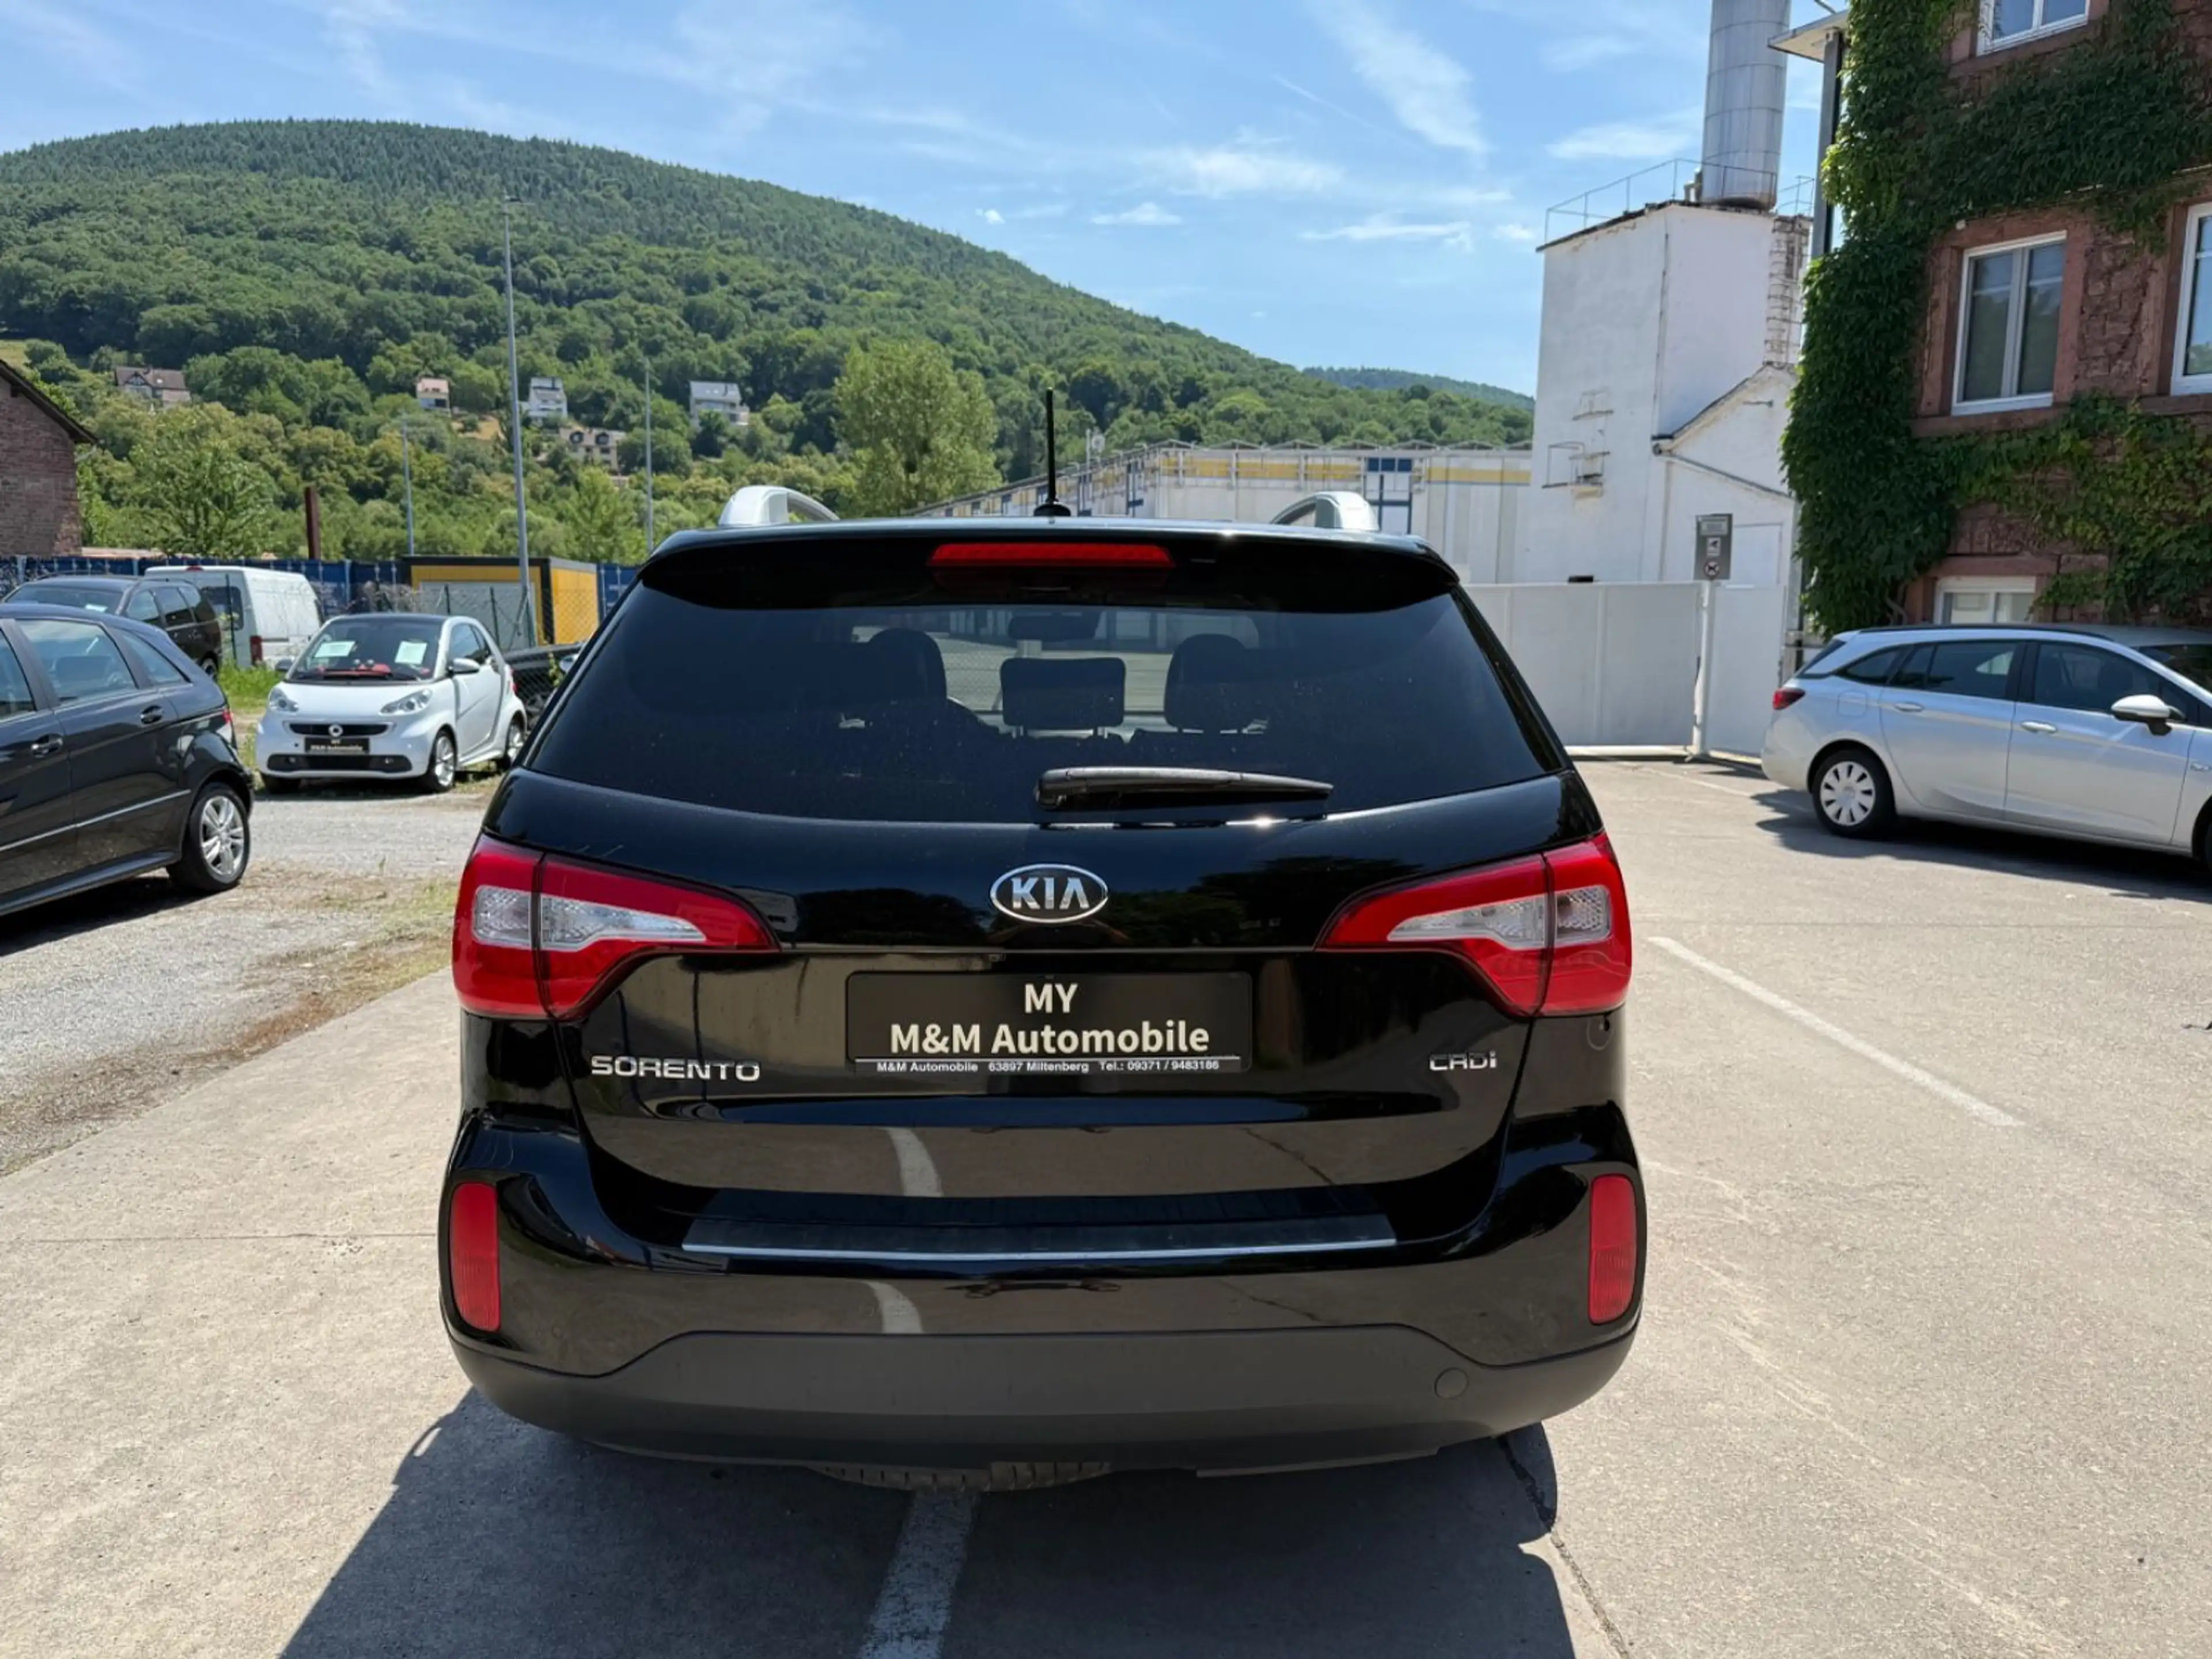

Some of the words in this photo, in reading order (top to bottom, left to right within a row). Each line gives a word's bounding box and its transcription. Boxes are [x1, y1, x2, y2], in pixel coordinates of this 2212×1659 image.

[1011, 876, 1090, 910] KIA
[1025, 983, 1078, 1013] MY
[890, 1023, 980, 1054] M&M
[991, 1020, 1210, 1054] Automobile
[591, 1055, 760, 1082] SORENTO
[876, 1062, 907, 1072] M&M
[910, 1062, 979, 1072] Automobile
[1027, 1061, 1090, 1074] Miltenberg
